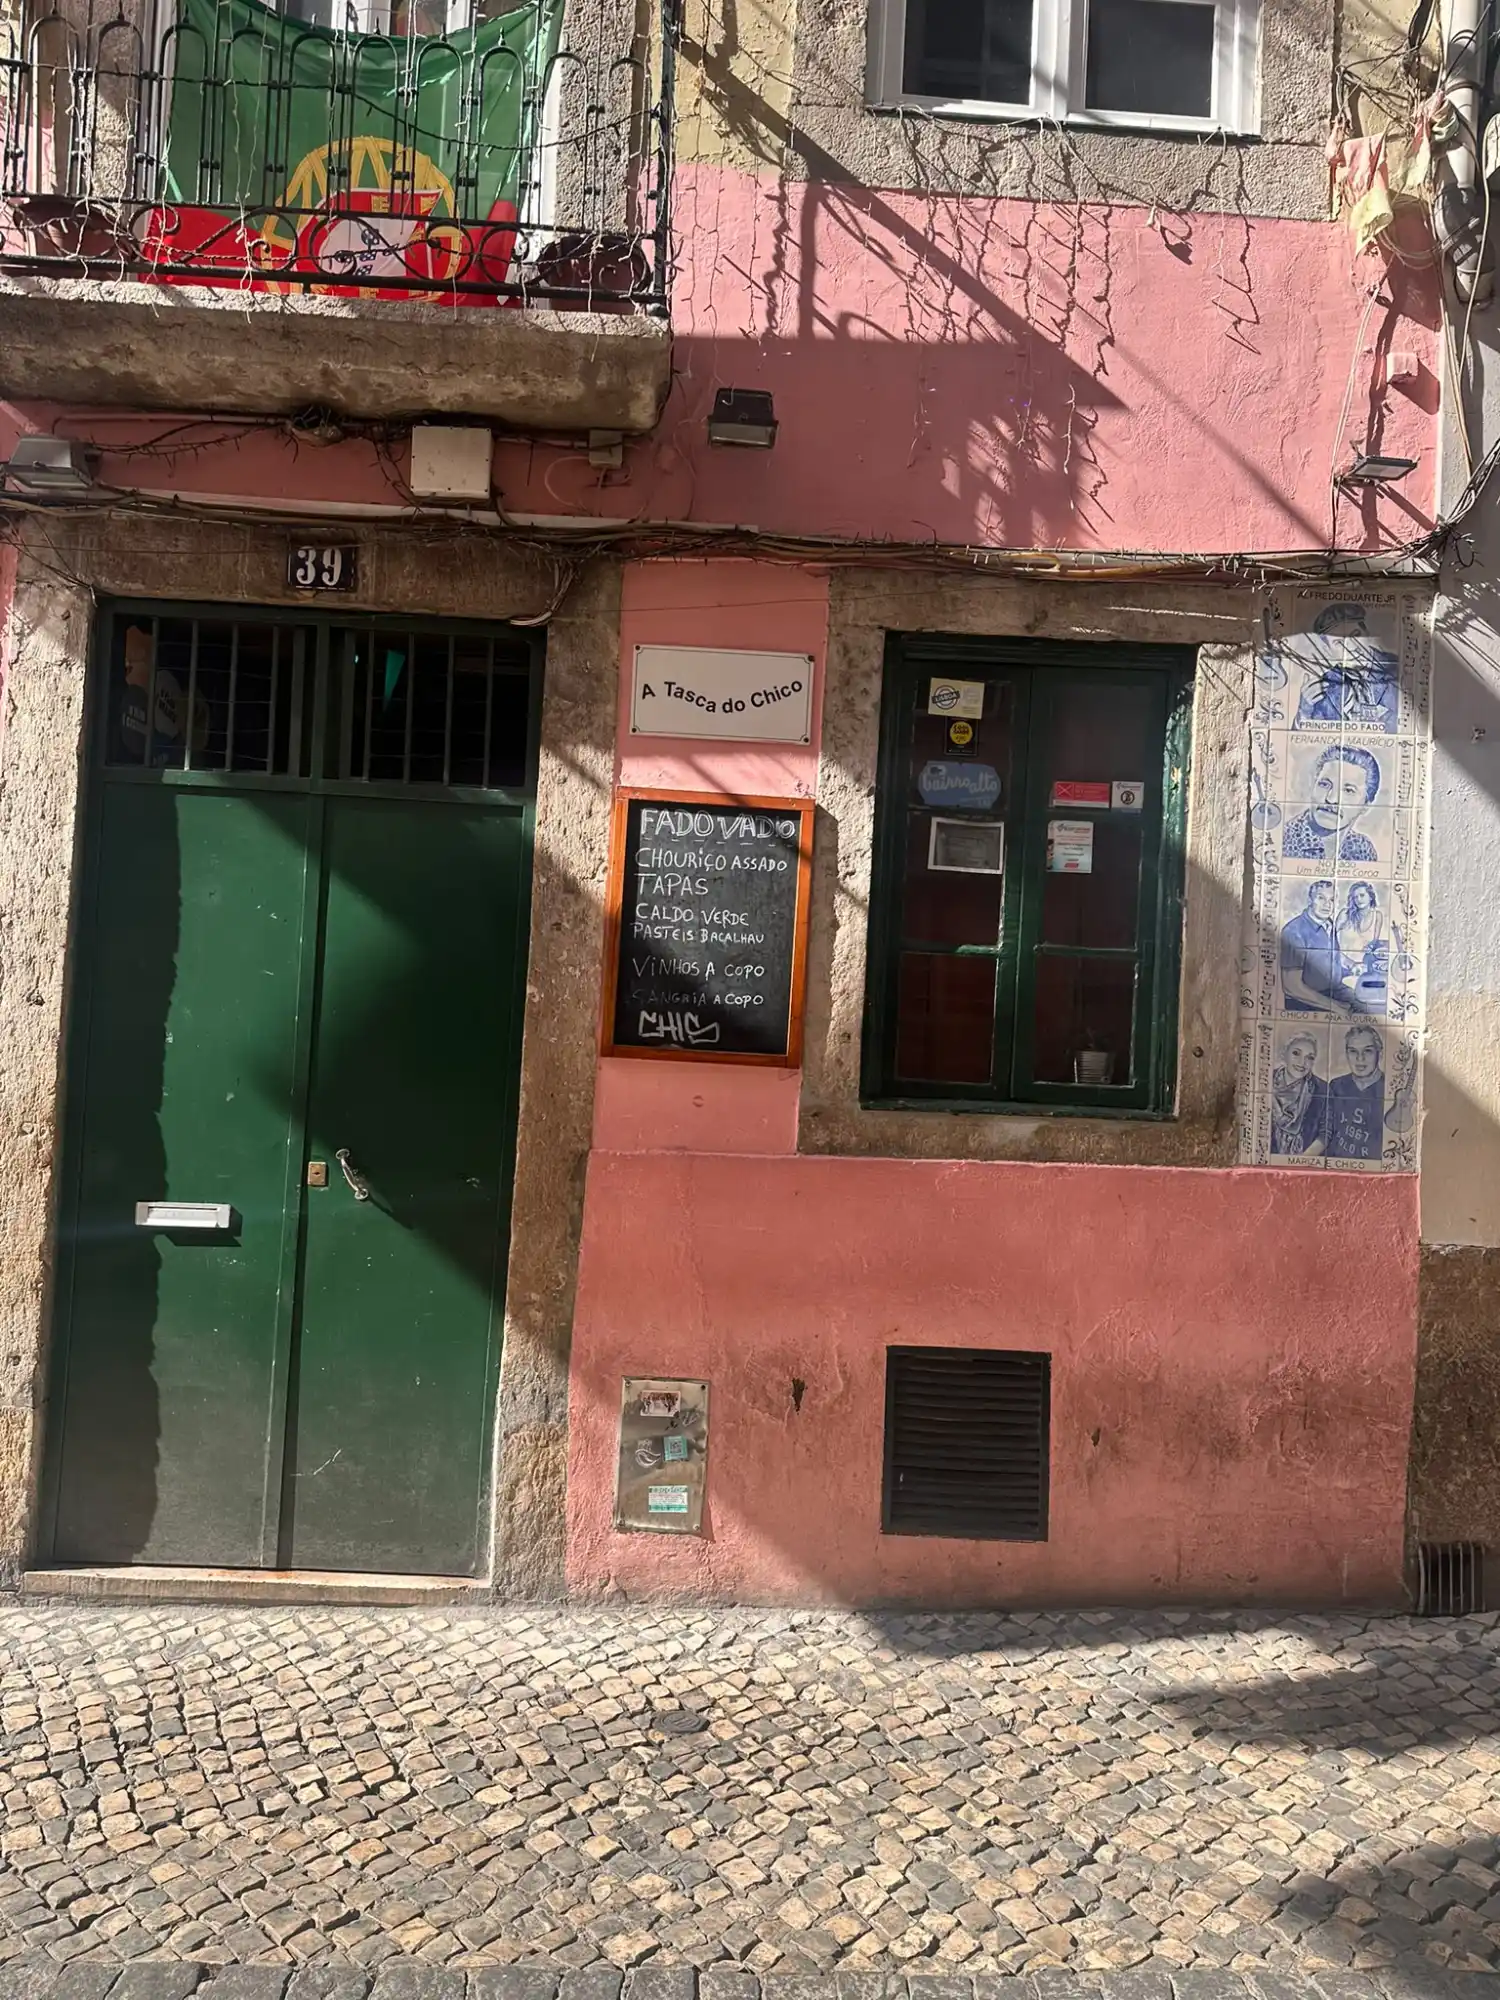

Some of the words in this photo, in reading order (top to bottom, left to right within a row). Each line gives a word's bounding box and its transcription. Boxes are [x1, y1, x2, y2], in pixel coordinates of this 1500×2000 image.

[296, 546, 342, 586] 39
[641, 683, 656, 700] A
[664, 681, 716, 713] Tasca
[722, 698, 746, 714] do
[750, 680, 803, 708] Chico
[1344, 722, 1358, 731] DO
[1360, 723, 1386, 731] FADO
[1290, 735, 1341, 745] FERNANDO
[640, 808, 714, 837] FADO
[730, 856, 788, 872] ASSADO
[634, 873, 709, 896] TAPAS
[635, 903, 694, 923] CALDO
[700, 906, 750, 928] VERDE
[631, 922, 694, 942] PASTEIS
[700, 928, 765, 944] BACALHAU
[705, 962, 716, 981] A
[724, 964, 765, 979] COPO
[713, 994, 721, 1005] A
[724, 993, 764, 1008] COPO
[1280, 1010, 1309, 1020] CHICO
[1287, 1157, 1322, 1167] MARIZA
[1325, 1159, 1331, 1168] E
[1335, 1160, 1365, 1170] CHICO
